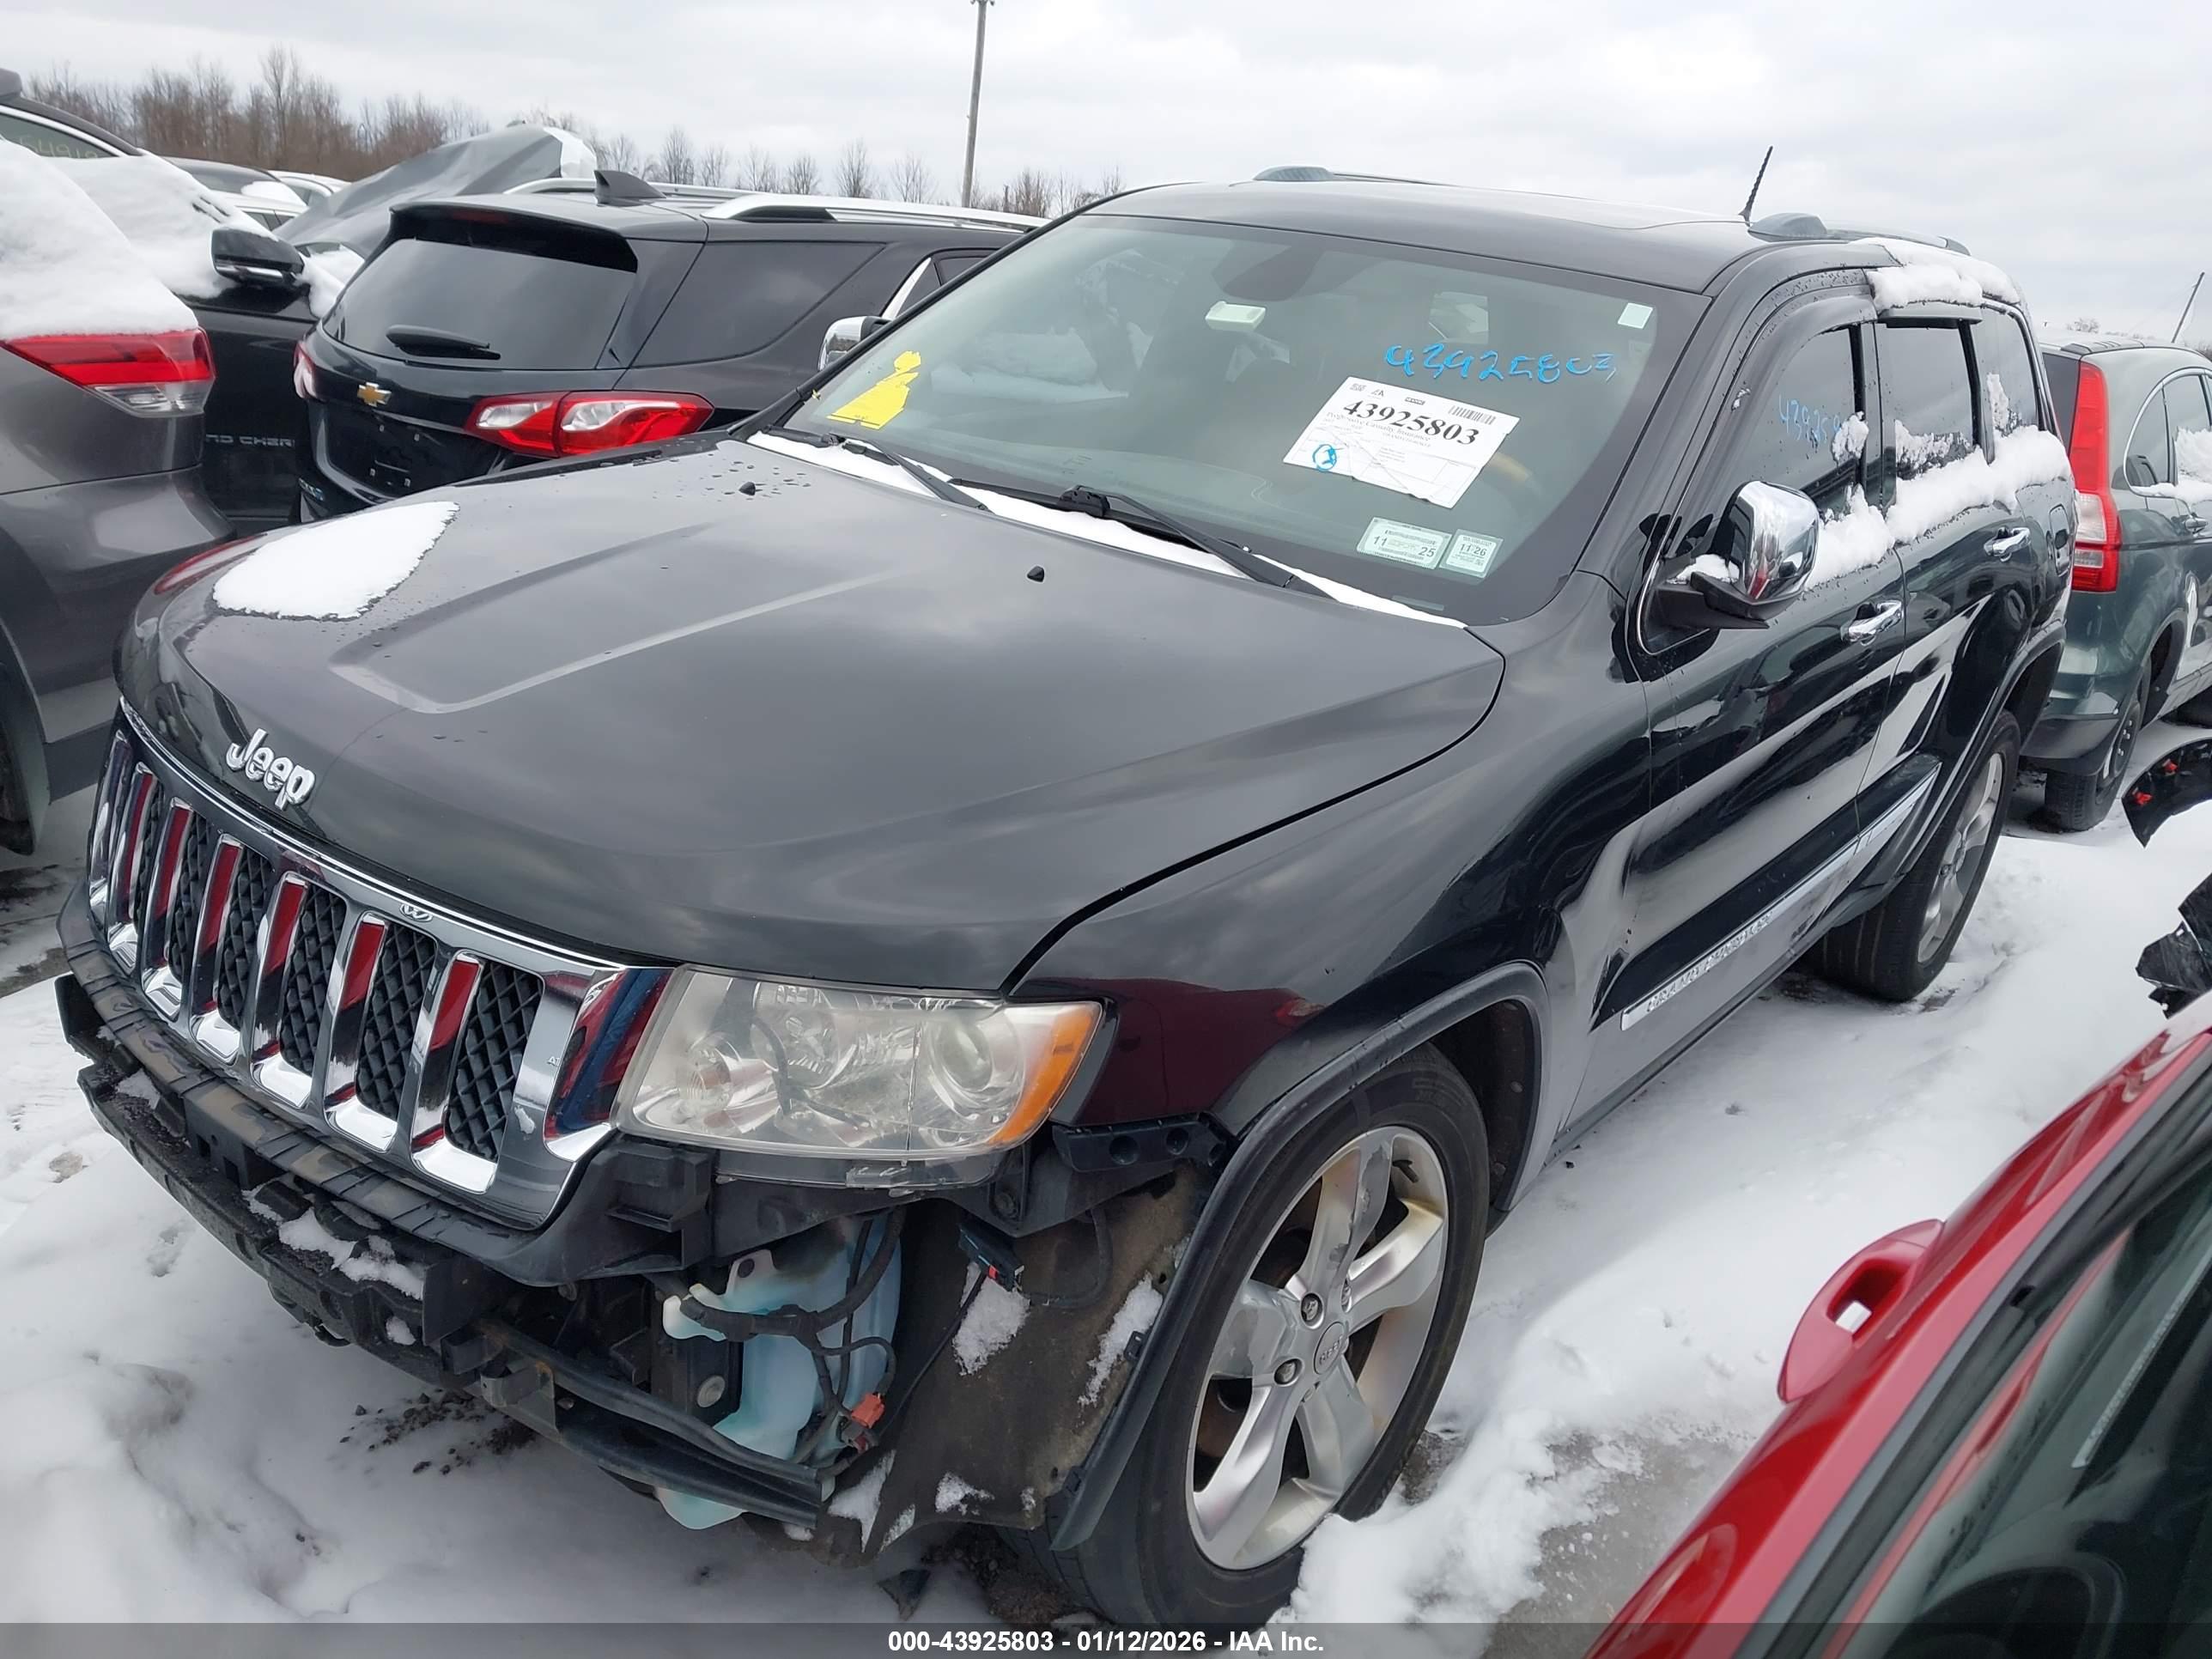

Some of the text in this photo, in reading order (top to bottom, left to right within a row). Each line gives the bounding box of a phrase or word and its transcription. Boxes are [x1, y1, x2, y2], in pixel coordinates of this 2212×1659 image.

[1344, 400, 1480, 446] 43925803
[1374, 536, 1387, 546] 11
[1418, 547, 1436, 557] 25
[226, 727, 316, 811] Jeep
